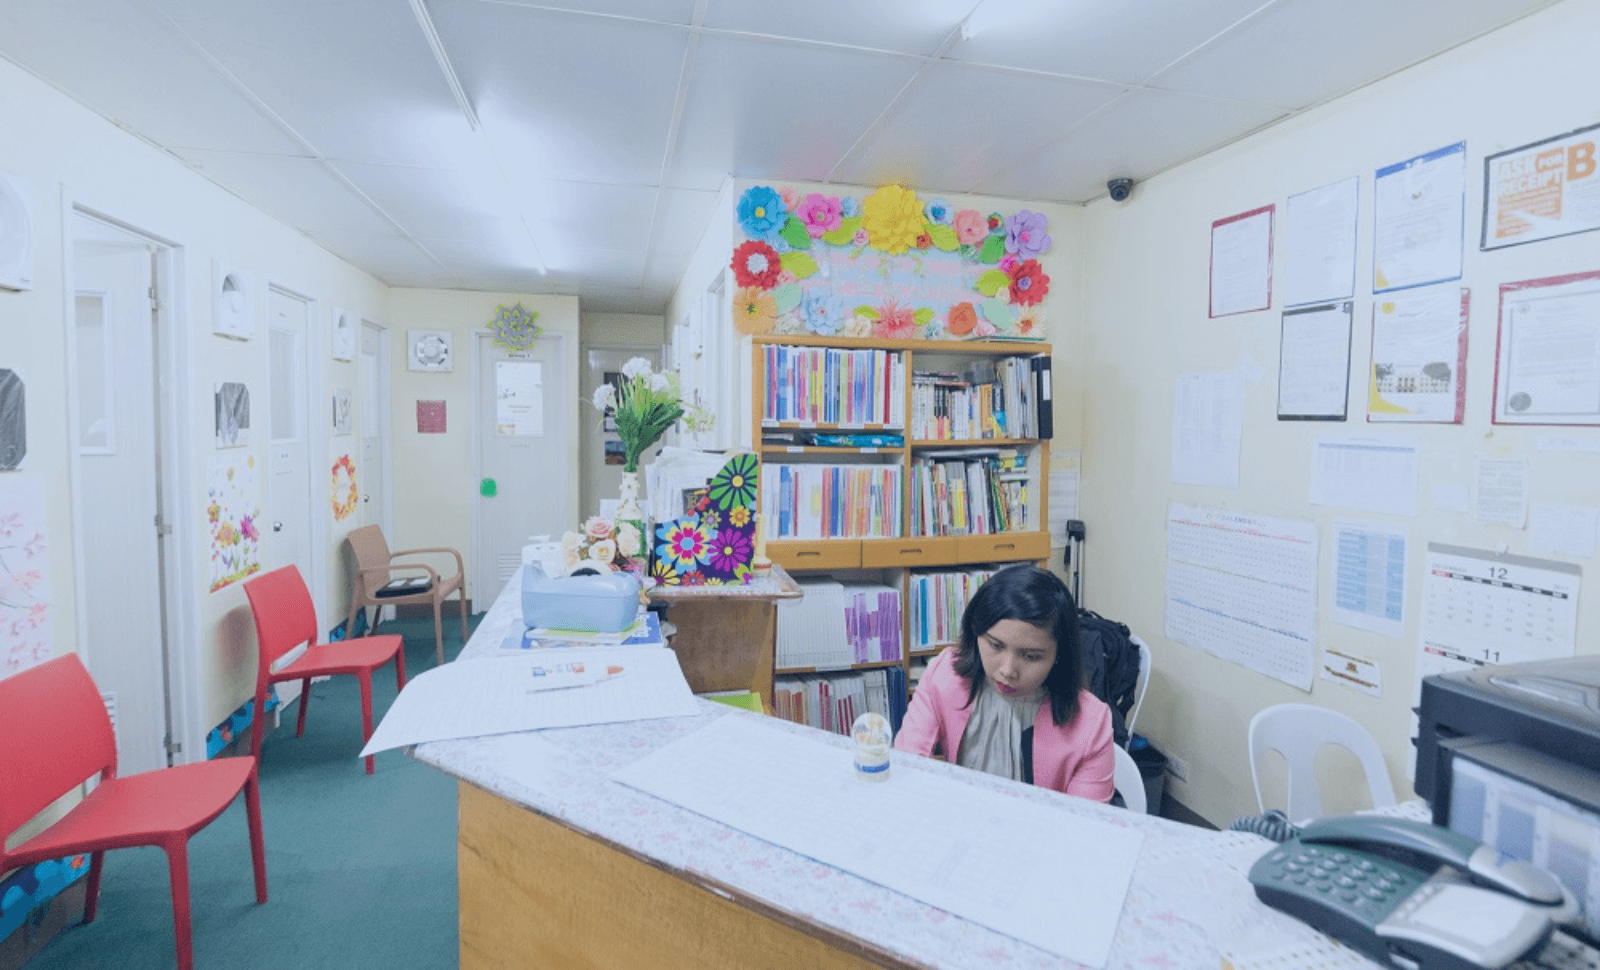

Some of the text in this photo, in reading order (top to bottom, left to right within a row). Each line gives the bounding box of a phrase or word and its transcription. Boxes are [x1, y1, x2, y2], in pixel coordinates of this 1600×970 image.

[1499, 154, 1563, 180] ASK FOR
[1567, 141, 1596, 181] B
[1499, 169, 1563, 197] RECEIPT
[1488, 566, 1508, 580] 12
[1482, 649, 1500, 663] 11
